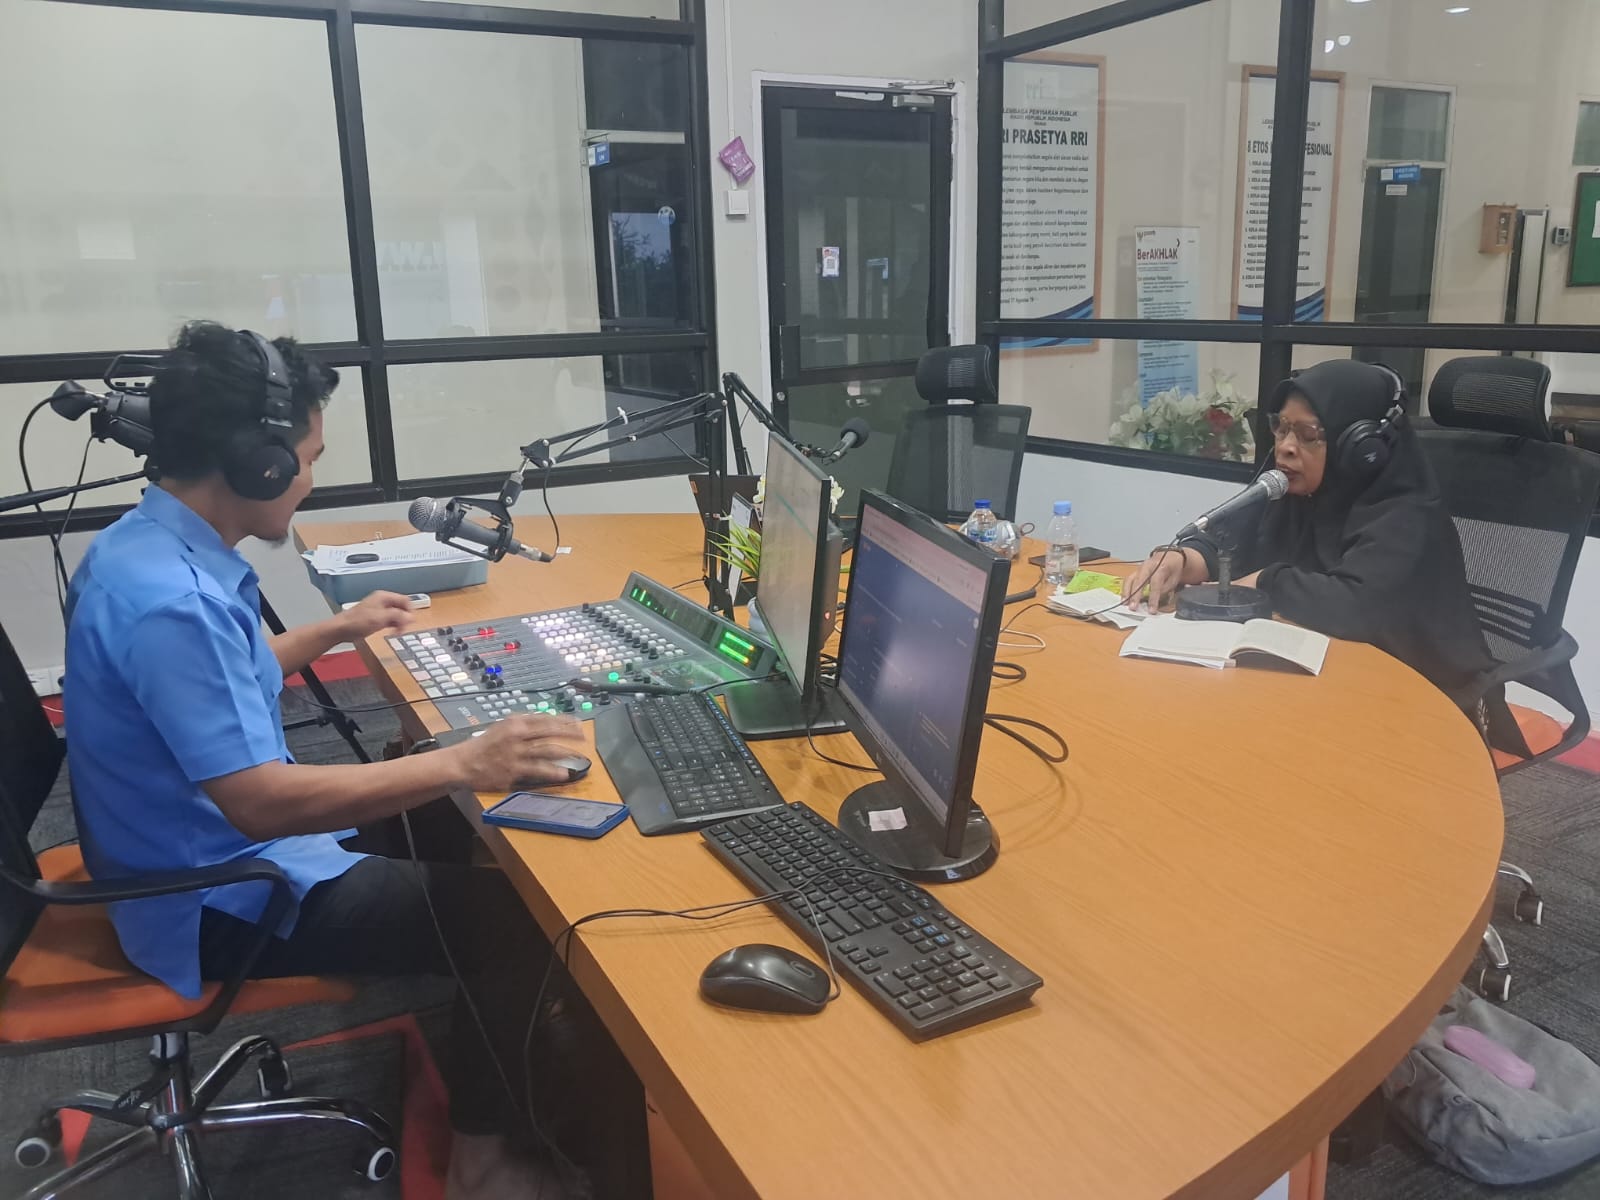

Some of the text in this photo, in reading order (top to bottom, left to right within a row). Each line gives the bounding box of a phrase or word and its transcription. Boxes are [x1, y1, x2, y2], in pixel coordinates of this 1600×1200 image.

[1012, 129, 1068, 145] PRASETYA
[1070, 131, 1088, 146] RRI
[1252, 141, 1269, 154] ETOS
[1137, 248, 1178, 260] BerAKHLAK
